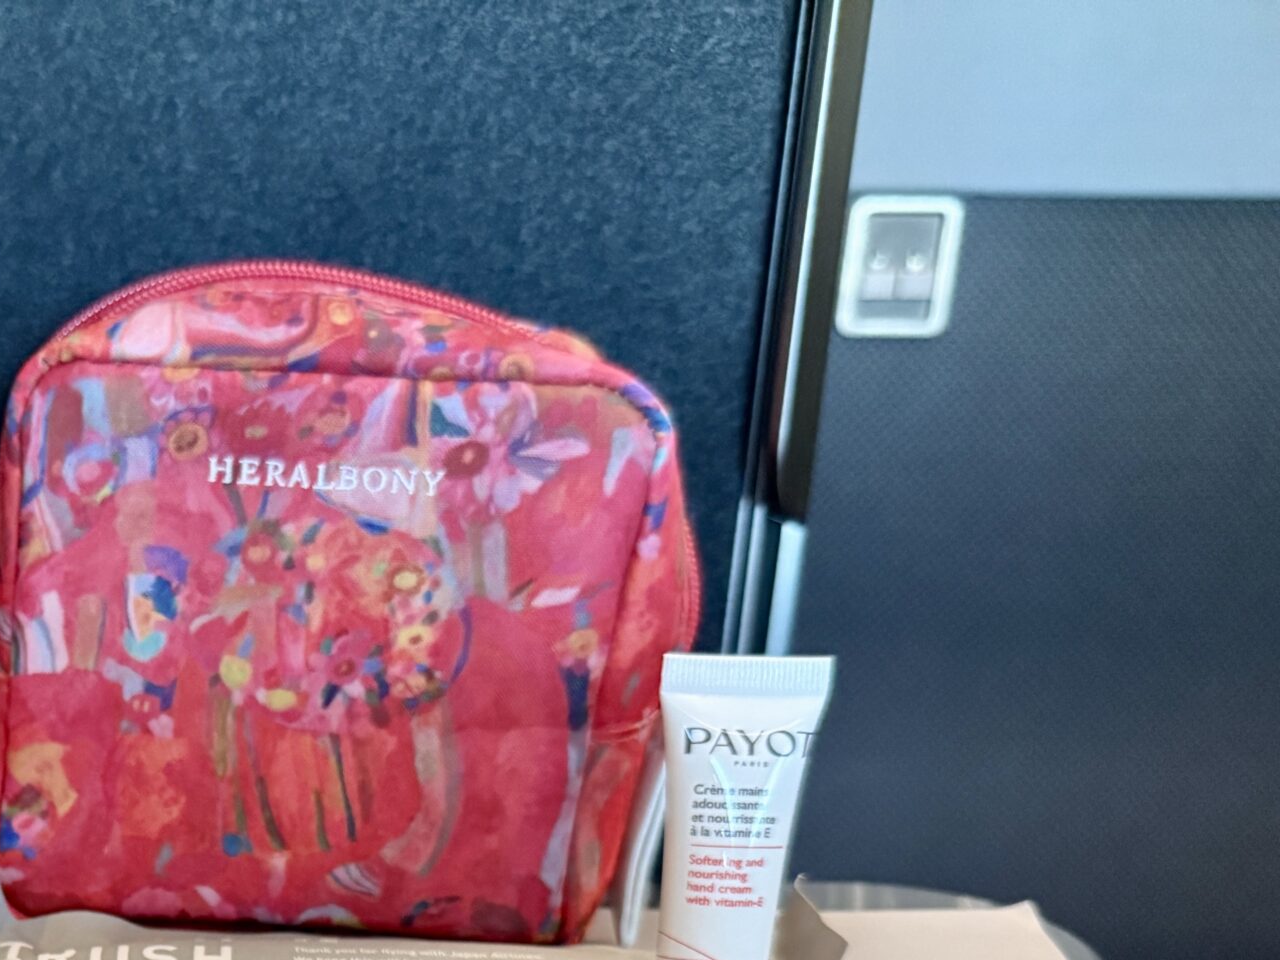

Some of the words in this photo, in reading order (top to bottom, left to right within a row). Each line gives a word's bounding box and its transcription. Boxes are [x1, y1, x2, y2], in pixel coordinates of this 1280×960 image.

[207, 455, 447, 496] HERALBONY
[684, 727, 818, 758] PAYOT
[691, 814, 704, 823] et
[745, 857, 764, 867] and
[687, 870, 749, 883] nourishing
[687, 881, 714, 893] hand
[718, 885, 753, 894] cream
[685, 896, 710, 906] with
